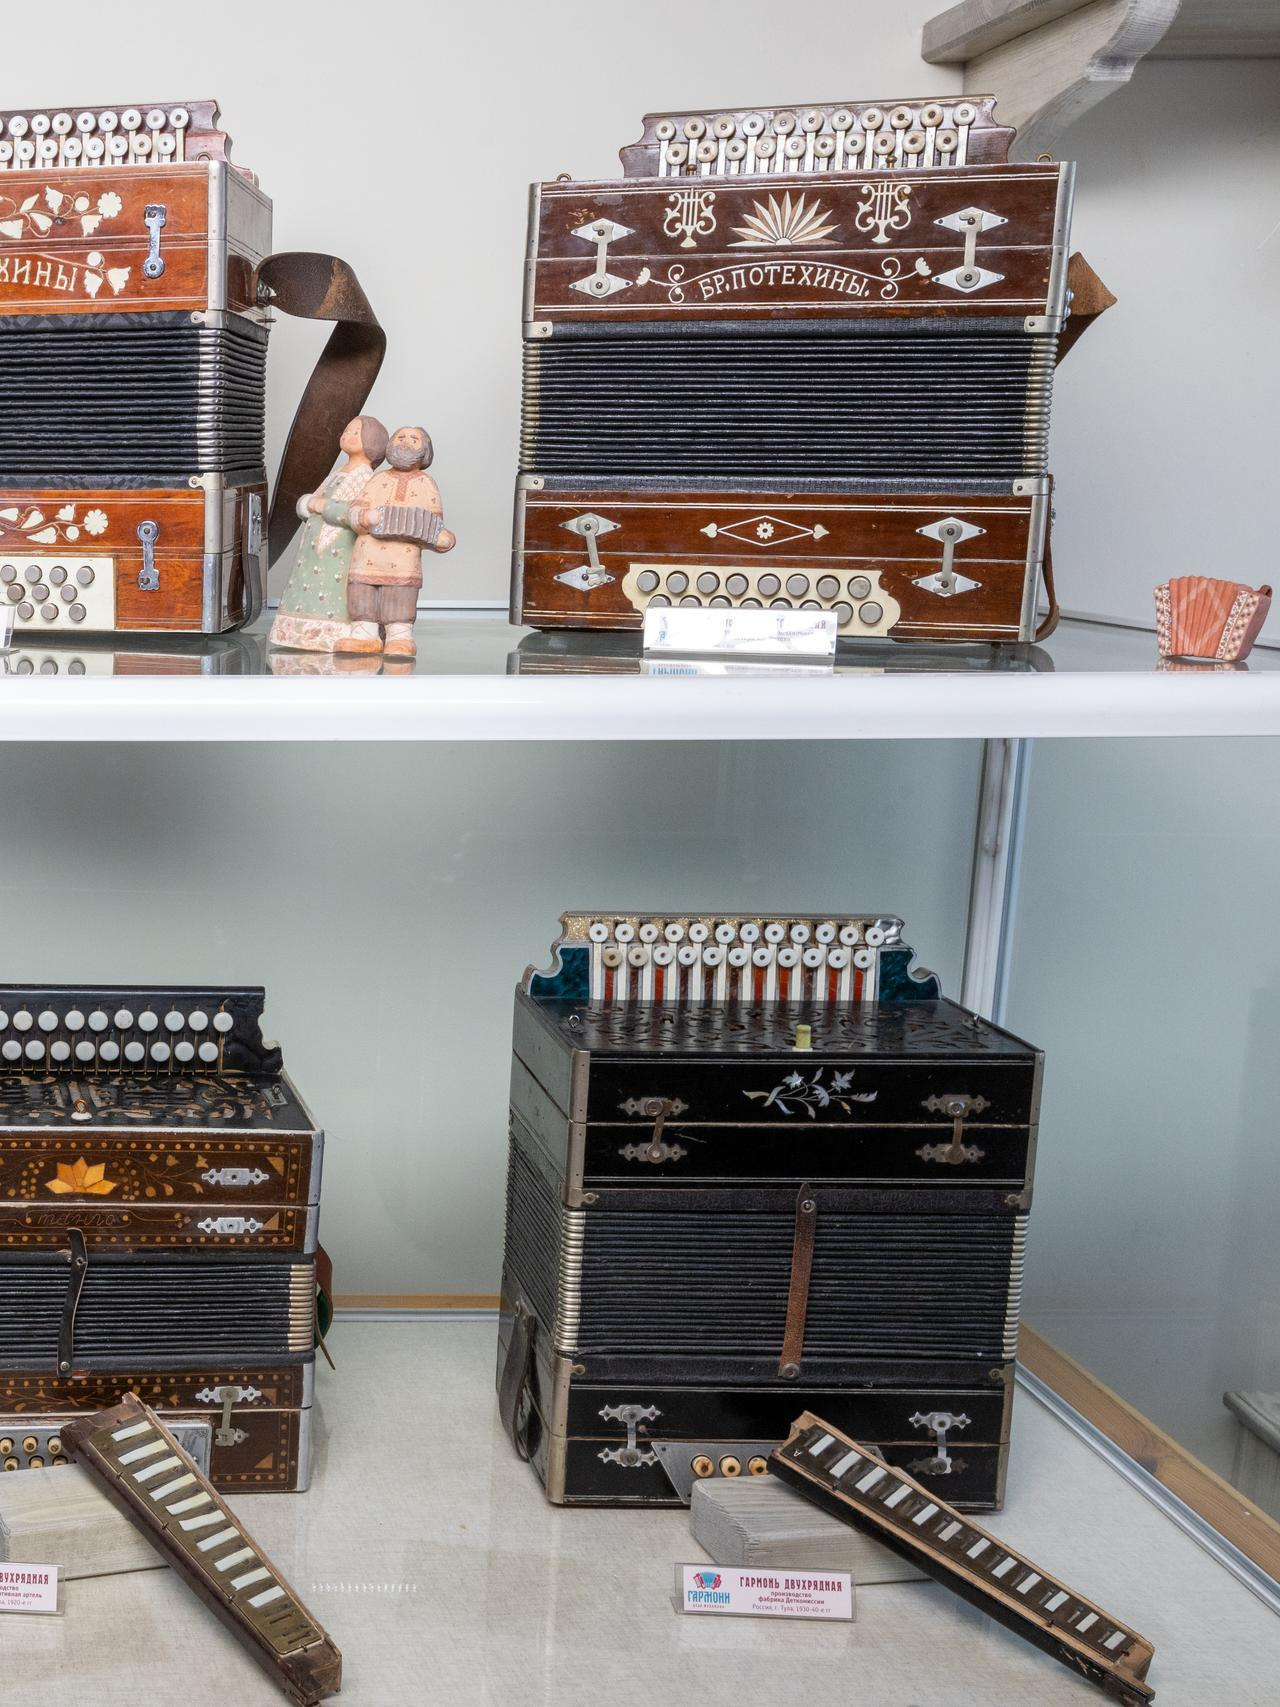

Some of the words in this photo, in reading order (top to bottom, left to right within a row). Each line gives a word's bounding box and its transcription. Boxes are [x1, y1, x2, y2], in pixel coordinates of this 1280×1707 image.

[740, 1576, 780, 1589] ГАРМОНЬ
[784, 1578, 842, 1592] ДВУХРЯДНАЯ
[758, 1595, 784, 1604] фабрика
[785, 1596, 825, 1605] Деткомиссии
[770, 1591, 812, 1599] производство
